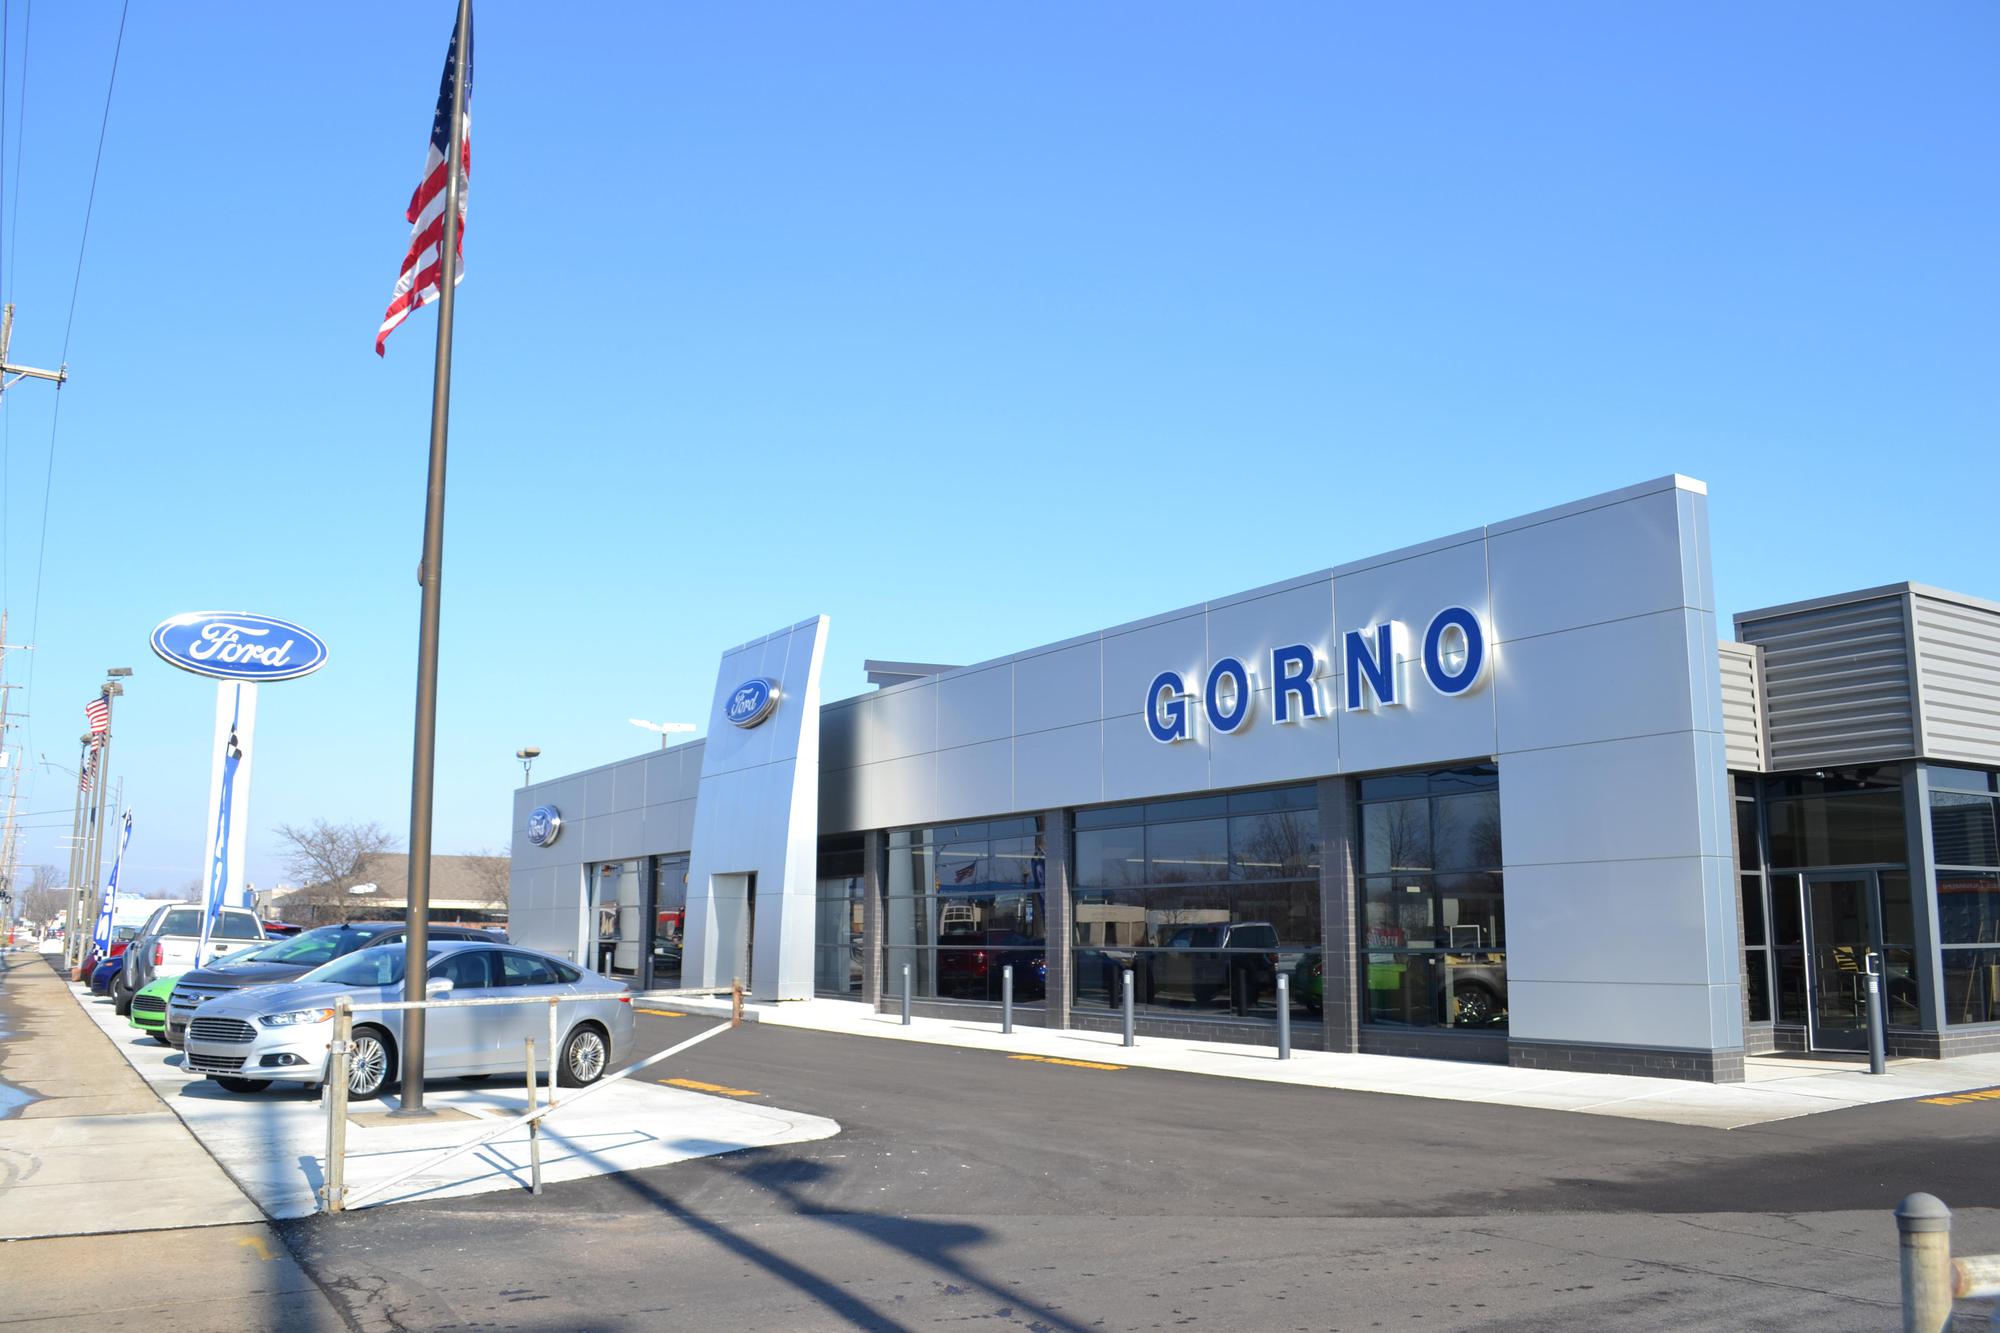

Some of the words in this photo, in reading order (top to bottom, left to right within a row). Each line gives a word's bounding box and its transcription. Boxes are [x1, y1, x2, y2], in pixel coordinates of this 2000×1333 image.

[188, 622, 294, 667] Ford
[1144, 605, 1486, 743] GORNO
[731, 688, 759, 716] Ford
